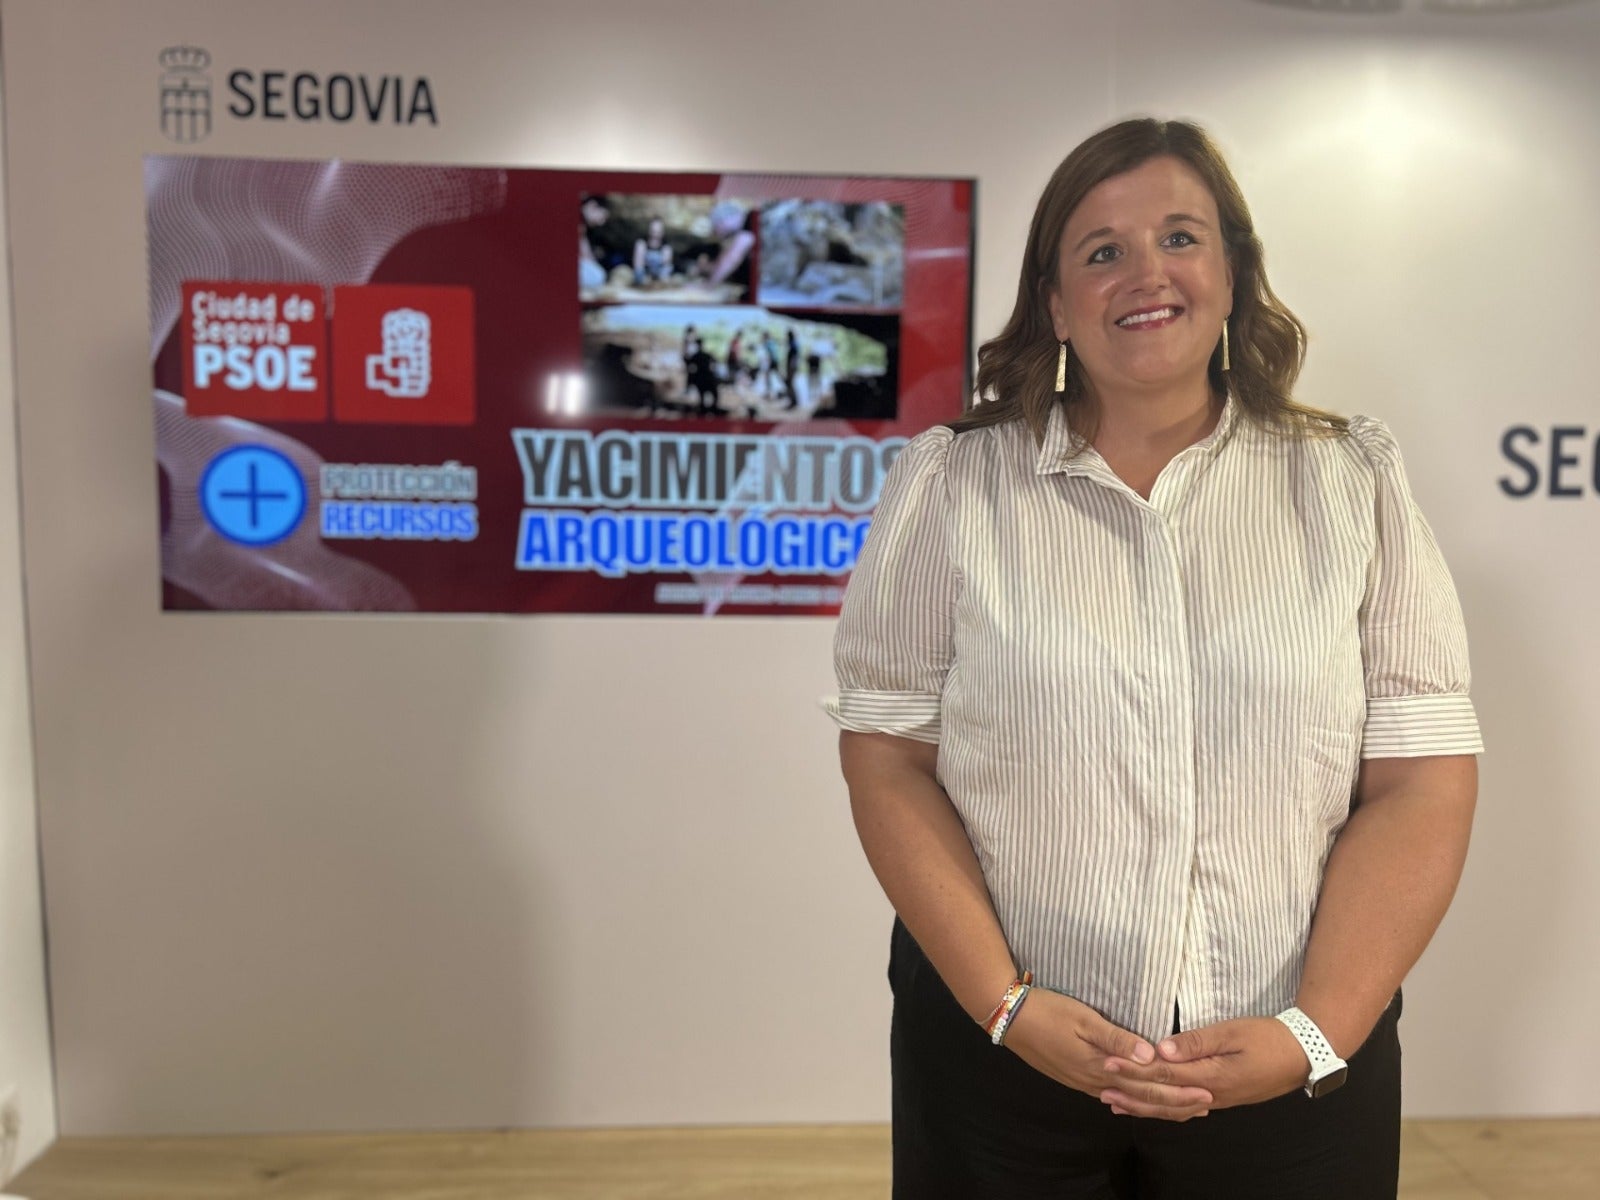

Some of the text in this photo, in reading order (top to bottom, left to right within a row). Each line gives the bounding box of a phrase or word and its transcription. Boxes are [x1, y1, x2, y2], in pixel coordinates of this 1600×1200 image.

[227, 69, 440, 127] SEGOVIA
[191, 290, 315, 322] Ciudad de
[192, 317, 291, 346] Segovia
[194, 344, 317, 390] PSOE
[1498, 424, 1600, 499] SE
[322, 502, 478, 540] RECURSOS
